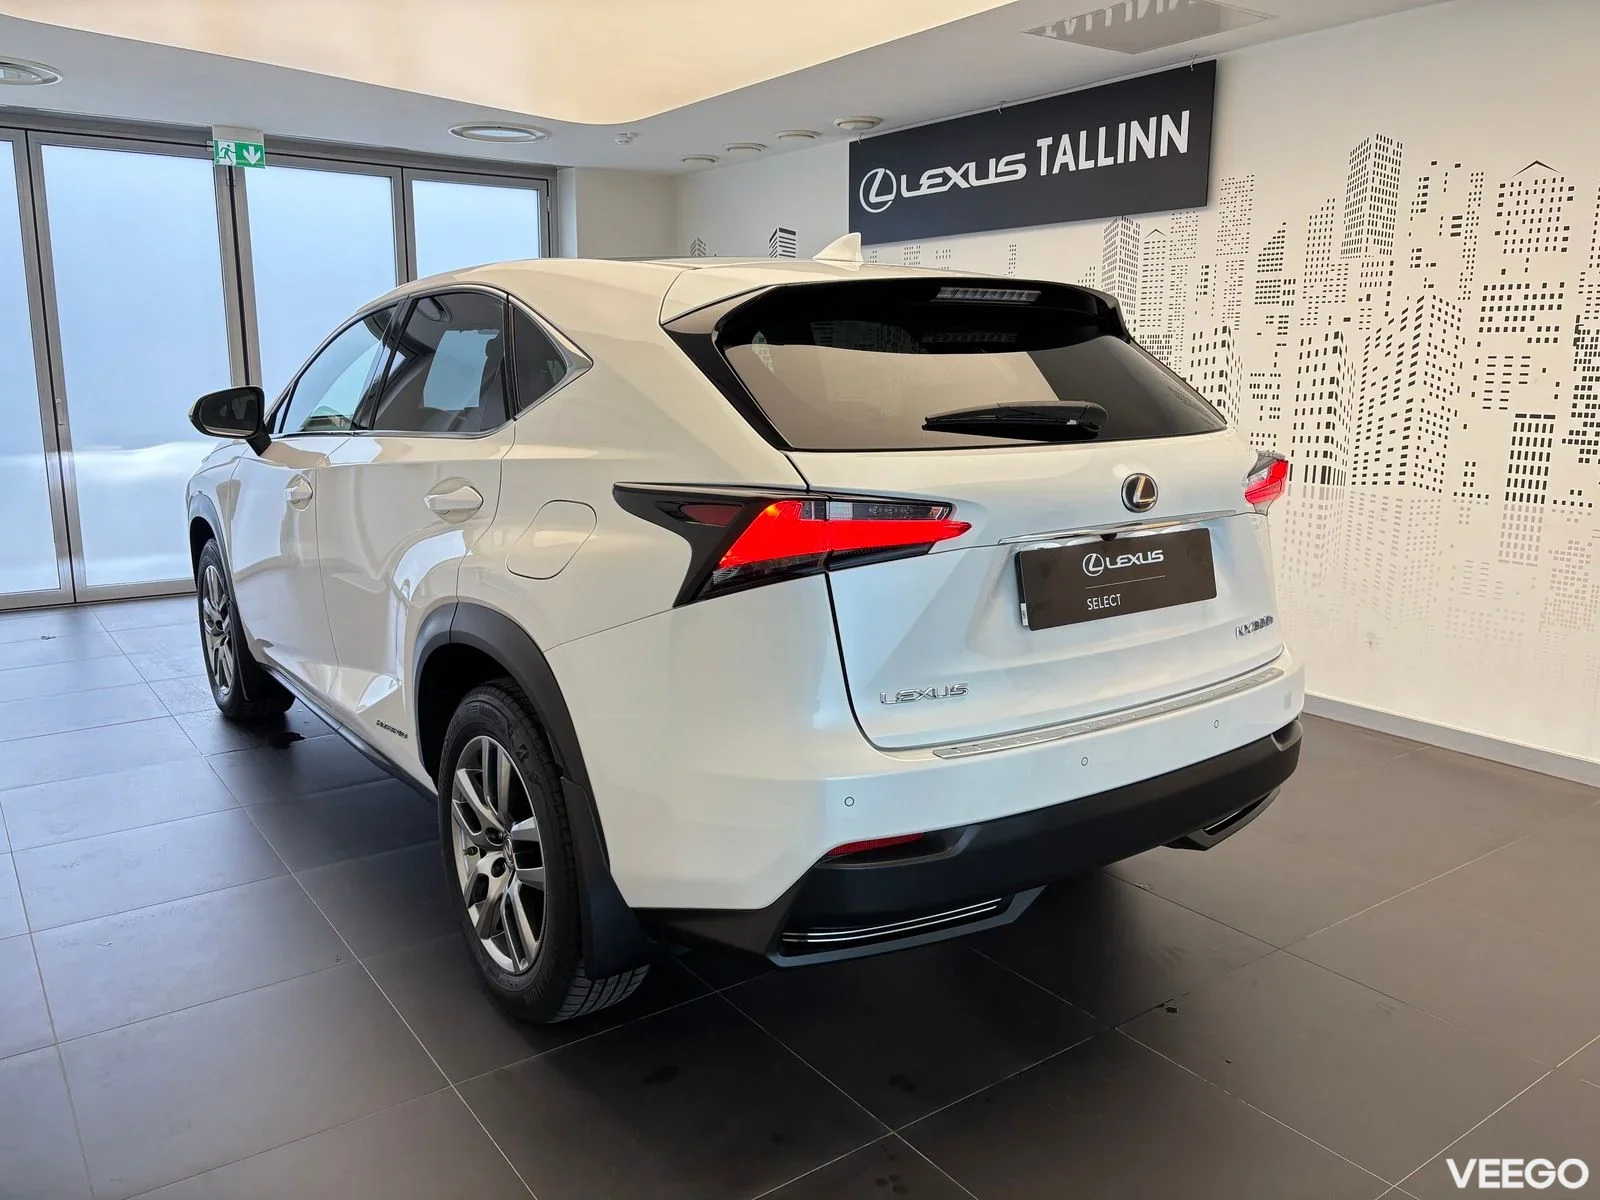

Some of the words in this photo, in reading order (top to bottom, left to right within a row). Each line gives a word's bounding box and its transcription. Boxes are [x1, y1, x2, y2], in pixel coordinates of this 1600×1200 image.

[901, 152, 1027, 198] LEXUS
[1036, 110, 1190, 176] TALLINN
[1105, 549, 1164, 569] LEXUS
[1086, 593, 1122, 611] SELECT
[879, 682, 969, 705] LEXUS
